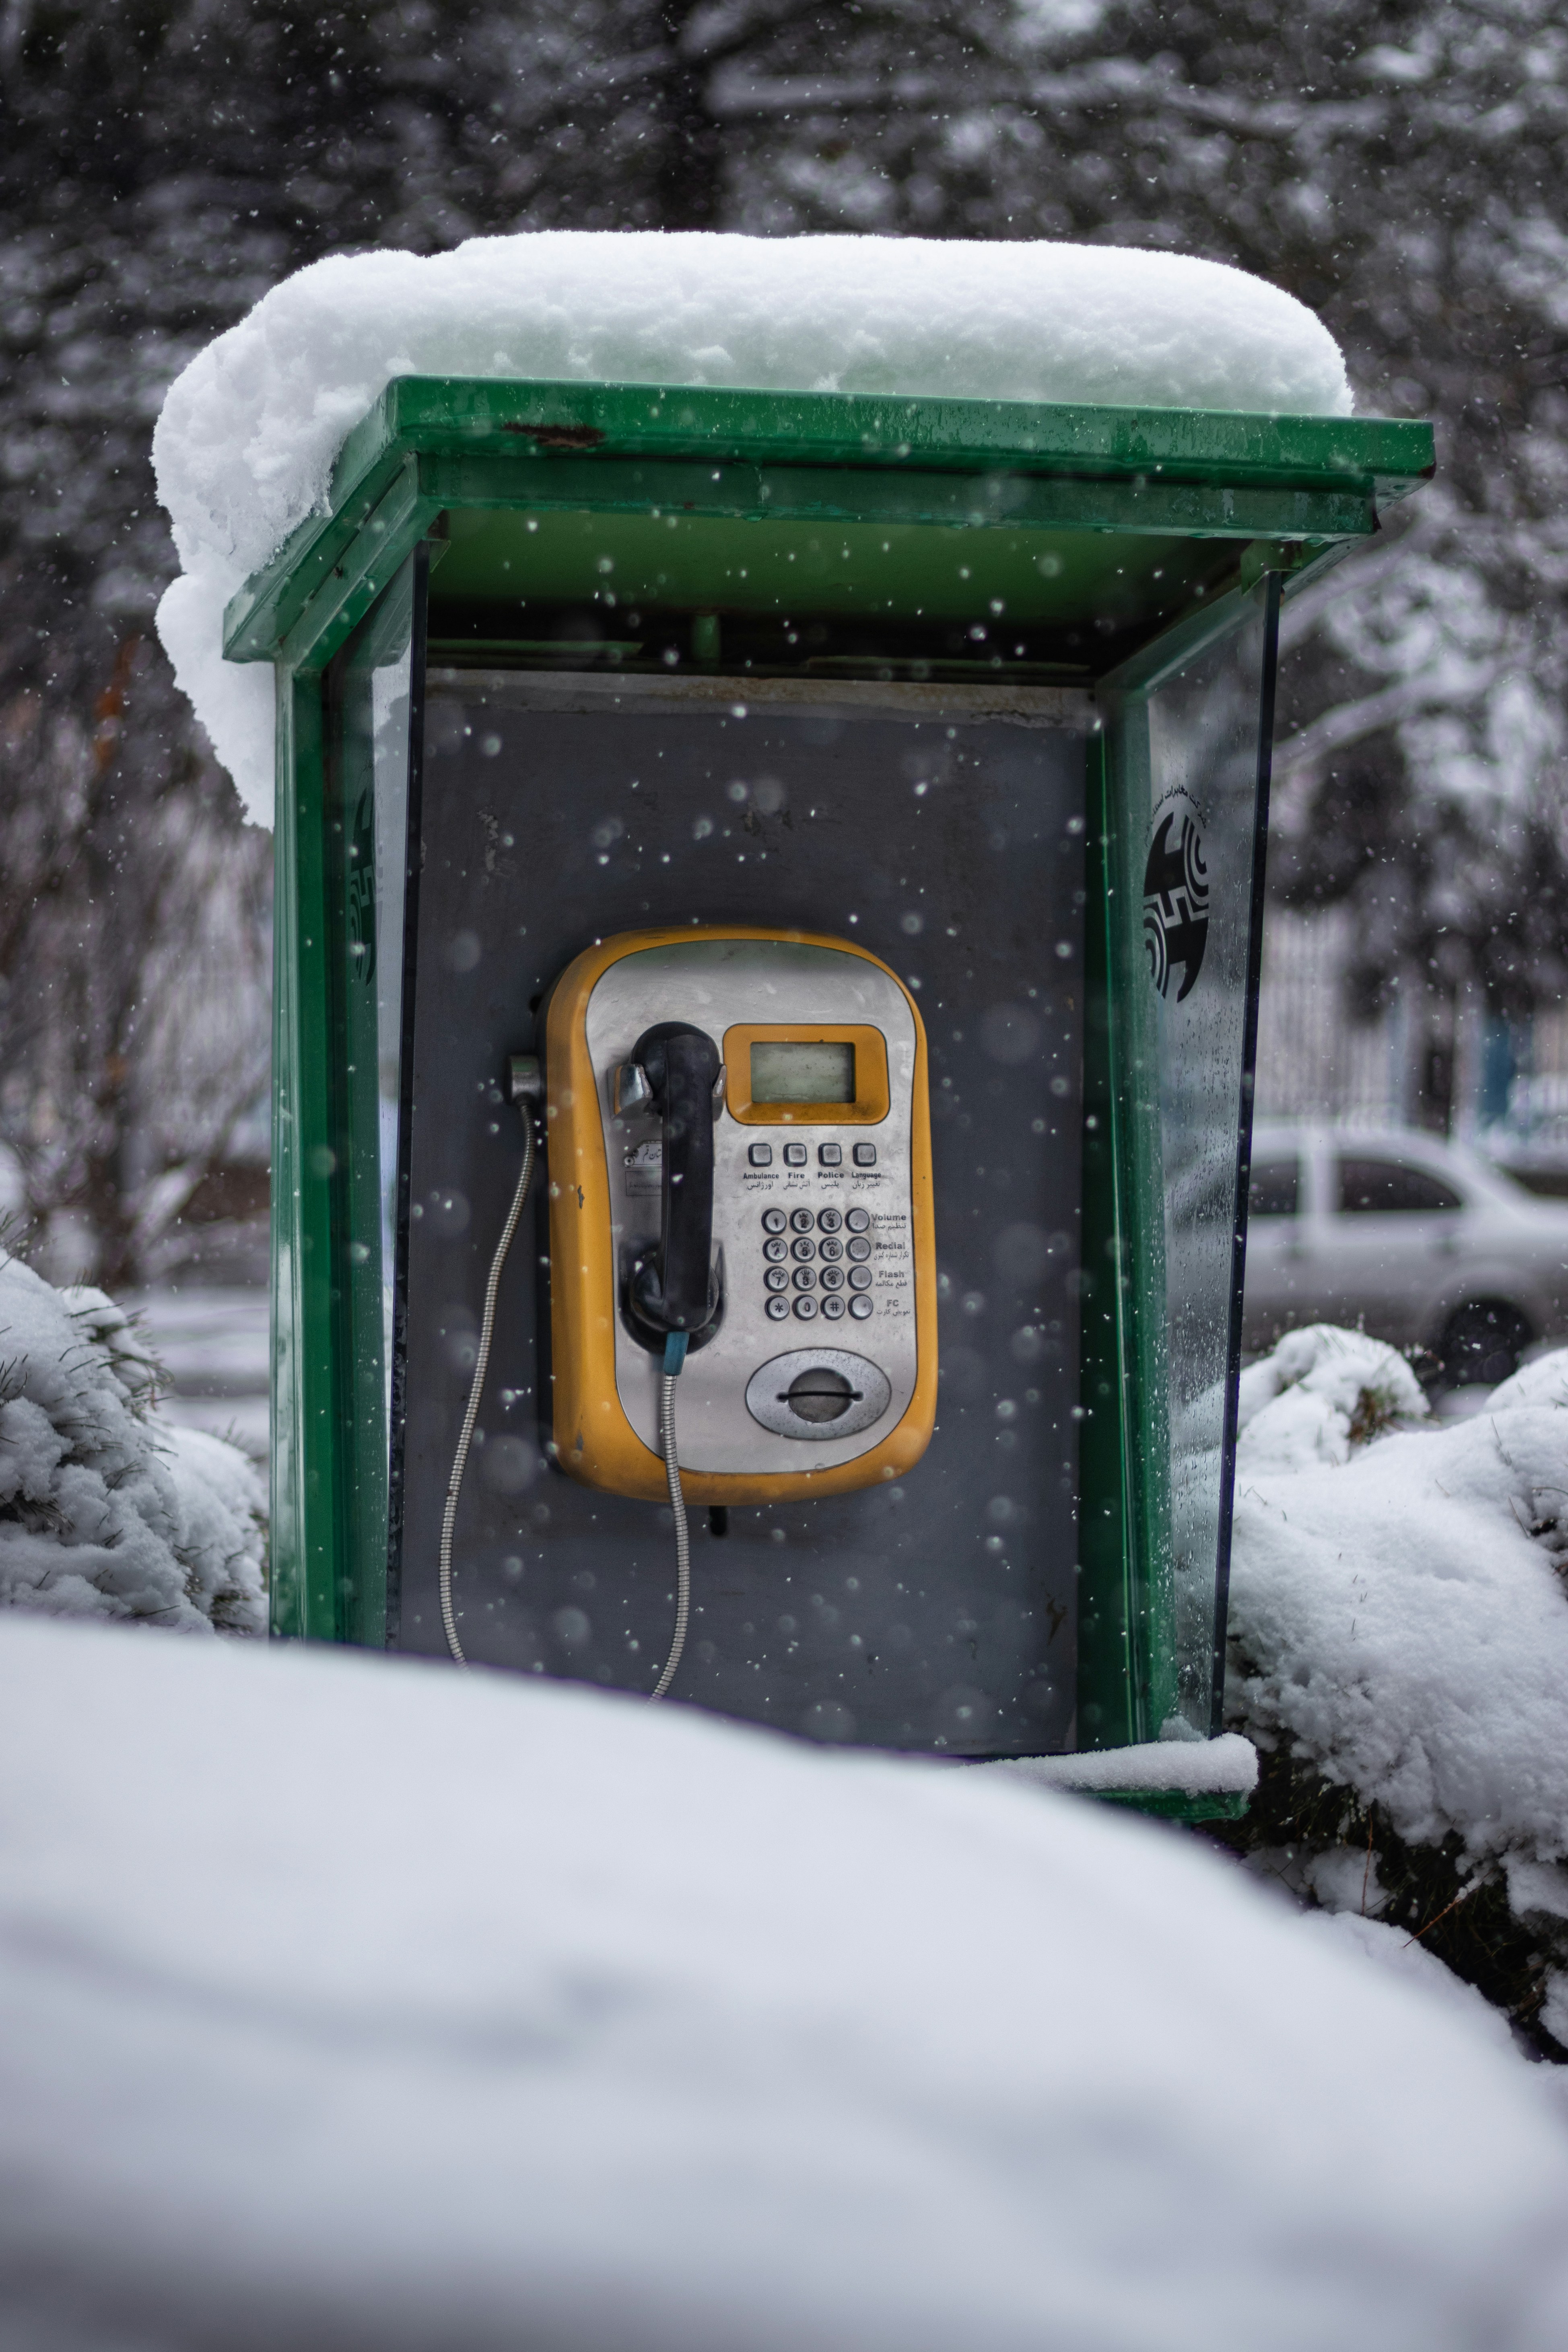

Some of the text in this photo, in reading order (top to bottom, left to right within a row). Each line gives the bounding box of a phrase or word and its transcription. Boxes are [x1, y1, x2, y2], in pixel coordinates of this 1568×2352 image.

[1164, 784, 1188, 799] مخابرات
[643, 1145, 649, 1162] قم
[747, 1181, 773, 1190] اورژانس
[783, 1179, 810, 1189] آتش نشانی
[821, 1181, 839, 1189] پلیس
[853, 1181, 880, 1189] تغییر زبان
[801, 1218, 807, 1228] 2
[828, 1218, 835, 1228] 3
[888, 1222, 906, 1231] تنظیم
[802, 1248, 808, 1256] 5
[829, 1247, 835, 1256] 6
[886, 1251, 898, 1260] شماره
[898, 1251, 909, 1260] تکرار
[777, 1276, 781, 1286] 7
[803, 1276, 809, 1286] 8
[830, 1276, 836, 1285] 9
[896, 1280, 907, 1288] قطع
[805, 1302, 811, 1312] 0
